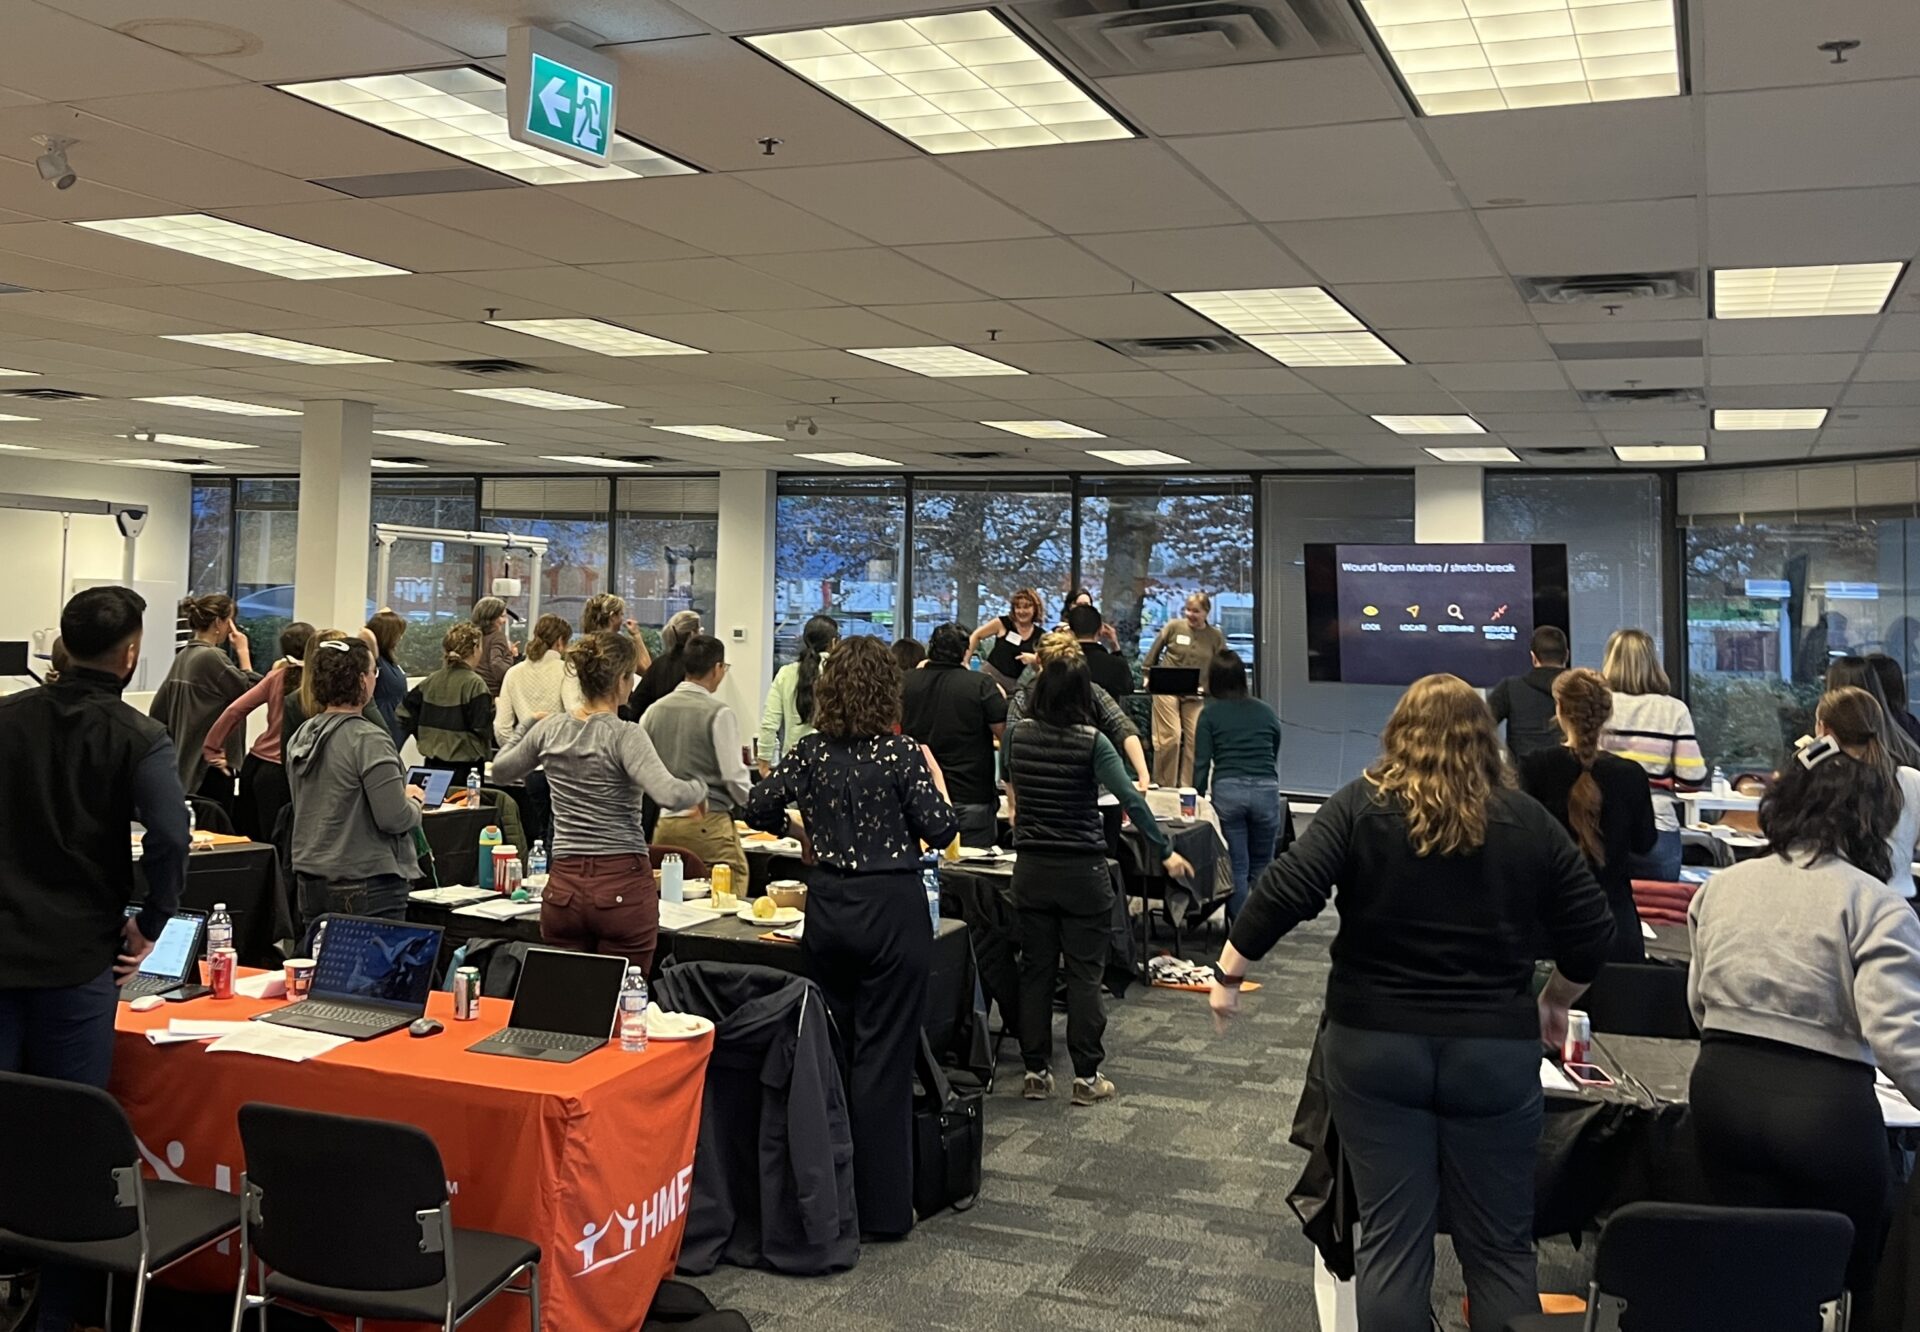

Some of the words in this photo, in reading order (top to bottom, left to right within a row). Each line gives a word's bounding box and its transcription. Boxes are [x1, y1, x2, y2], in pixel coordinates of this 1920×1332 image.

[1342, 563, 1376, 573] Wound
[1378, 563, 1405, 573] Team
[1406, 563, 1442, 573] Mantra
[1450, 563, 1484, 573] stretch
[1485, 563, 1516, 573] break
[640, 1163, 693, 1247] HME
